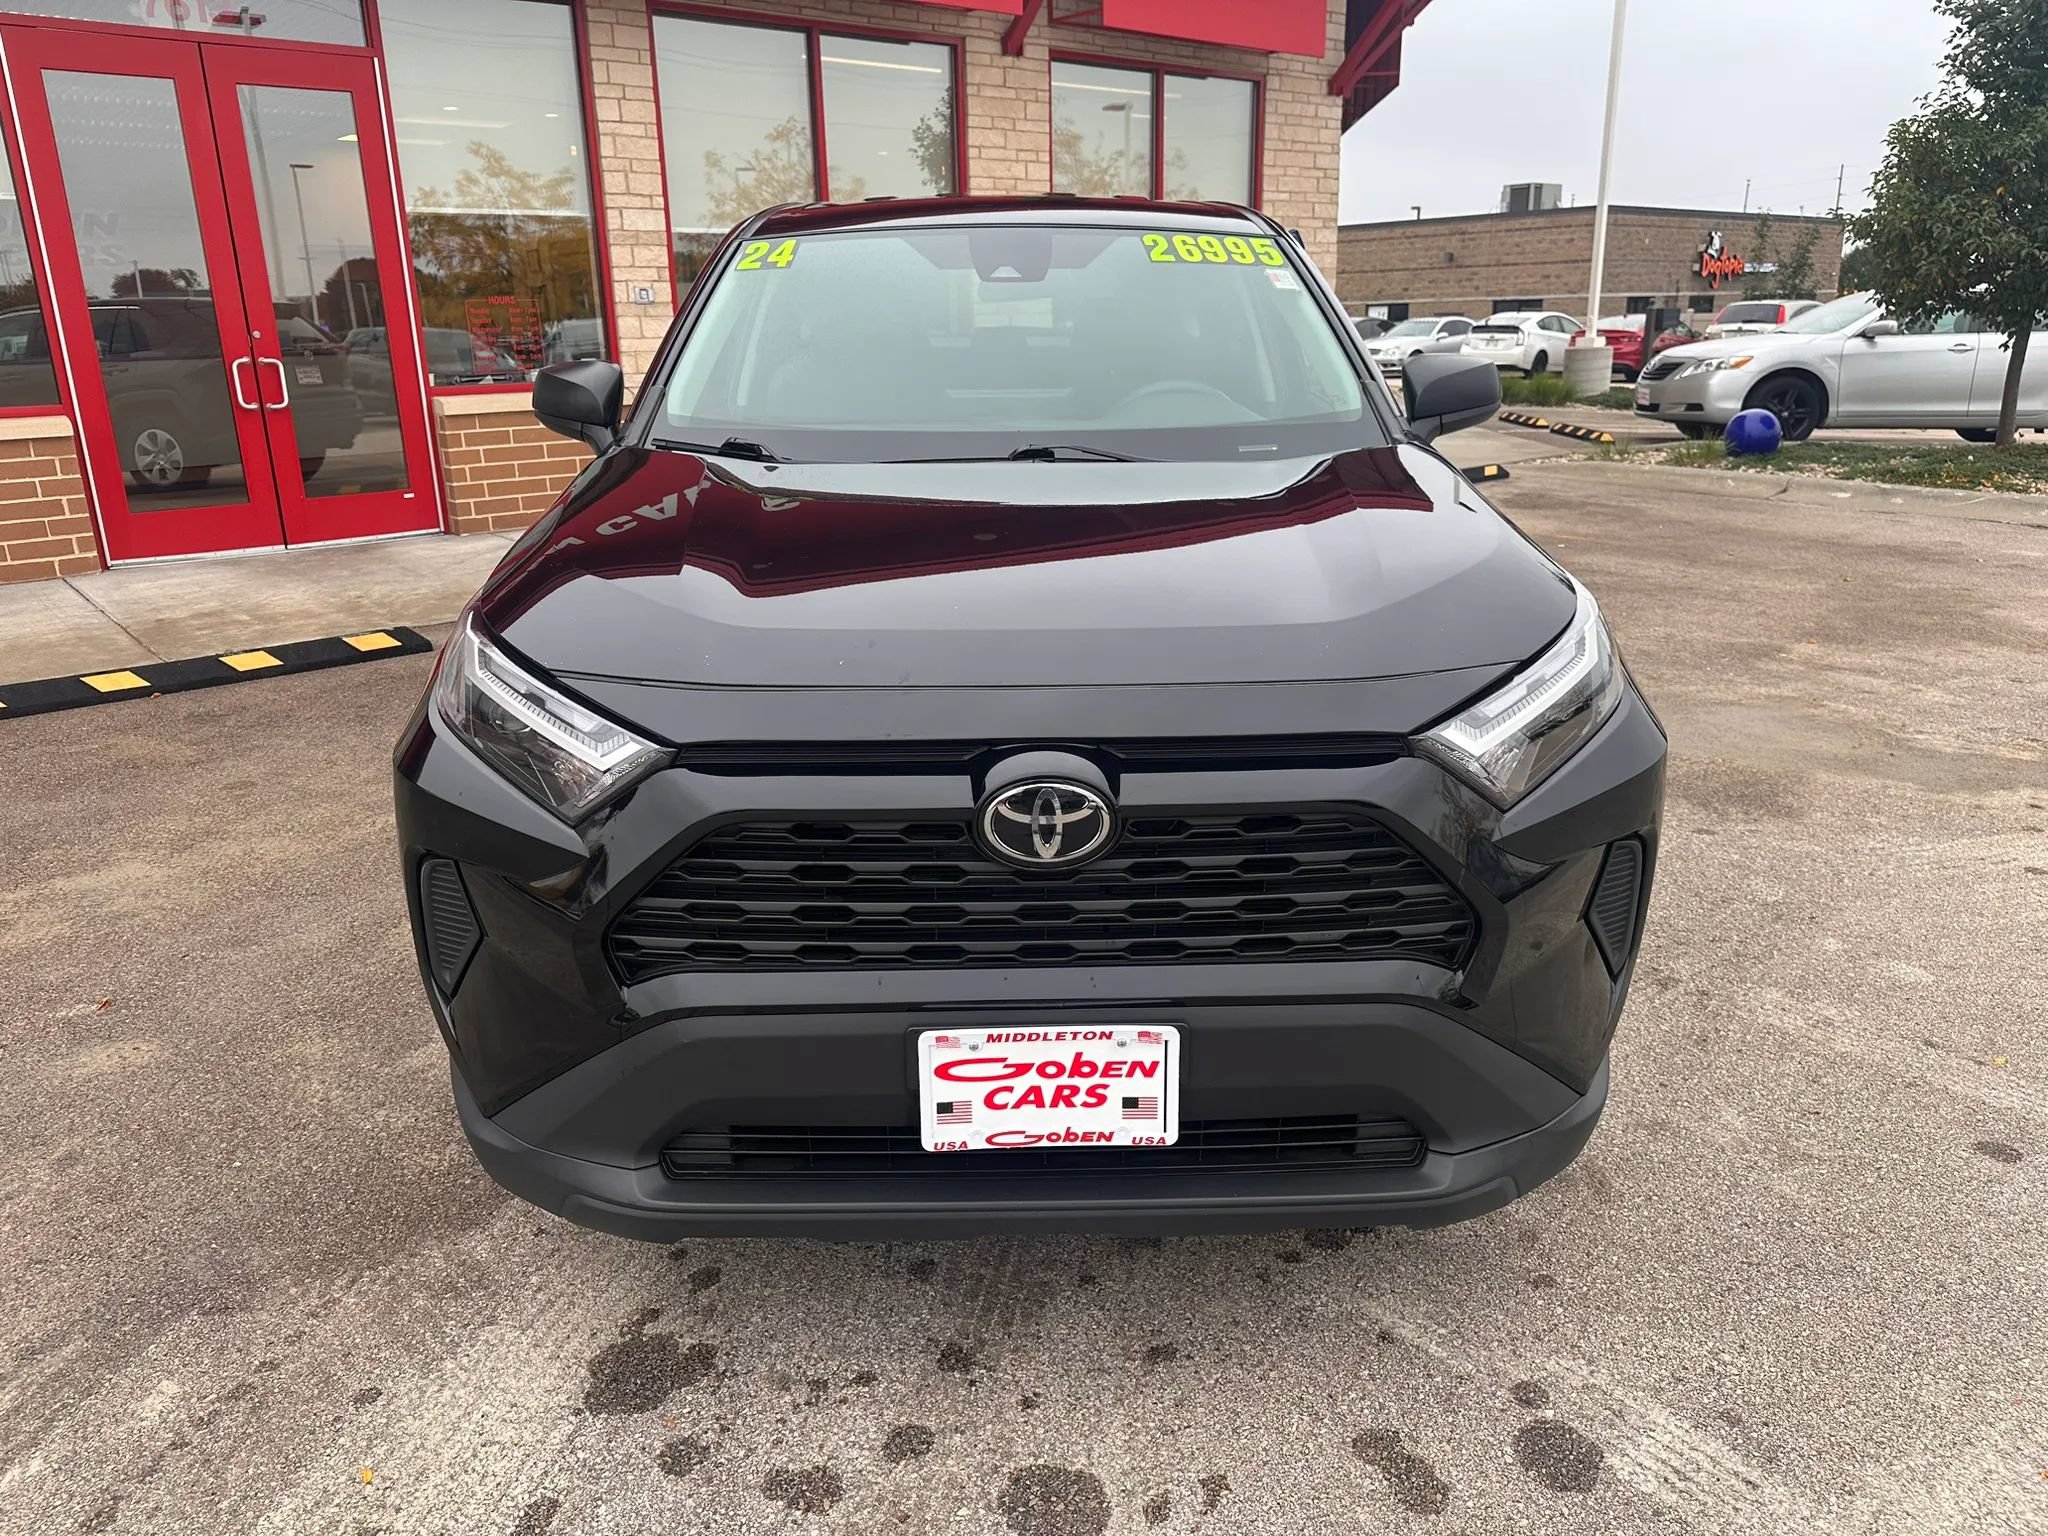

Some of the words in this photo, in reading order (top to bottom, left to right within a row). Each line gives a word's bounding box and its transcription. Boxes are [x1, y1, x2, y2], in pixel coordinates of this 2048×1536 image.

[736, 239, 797, 271] 24
[1142, 234, 1285, 266] 26995
[1702, 246, 1744, 289] Dogtopia
[489, 296, 515, 304] HOURS
[986, 1030, 1113, 1044] MIDDLETON
[983, 1083, 1110, 1110] CARS
[933, 1141, 969, 1151] USA
[1132, 1136, 1167, 1146] USA
